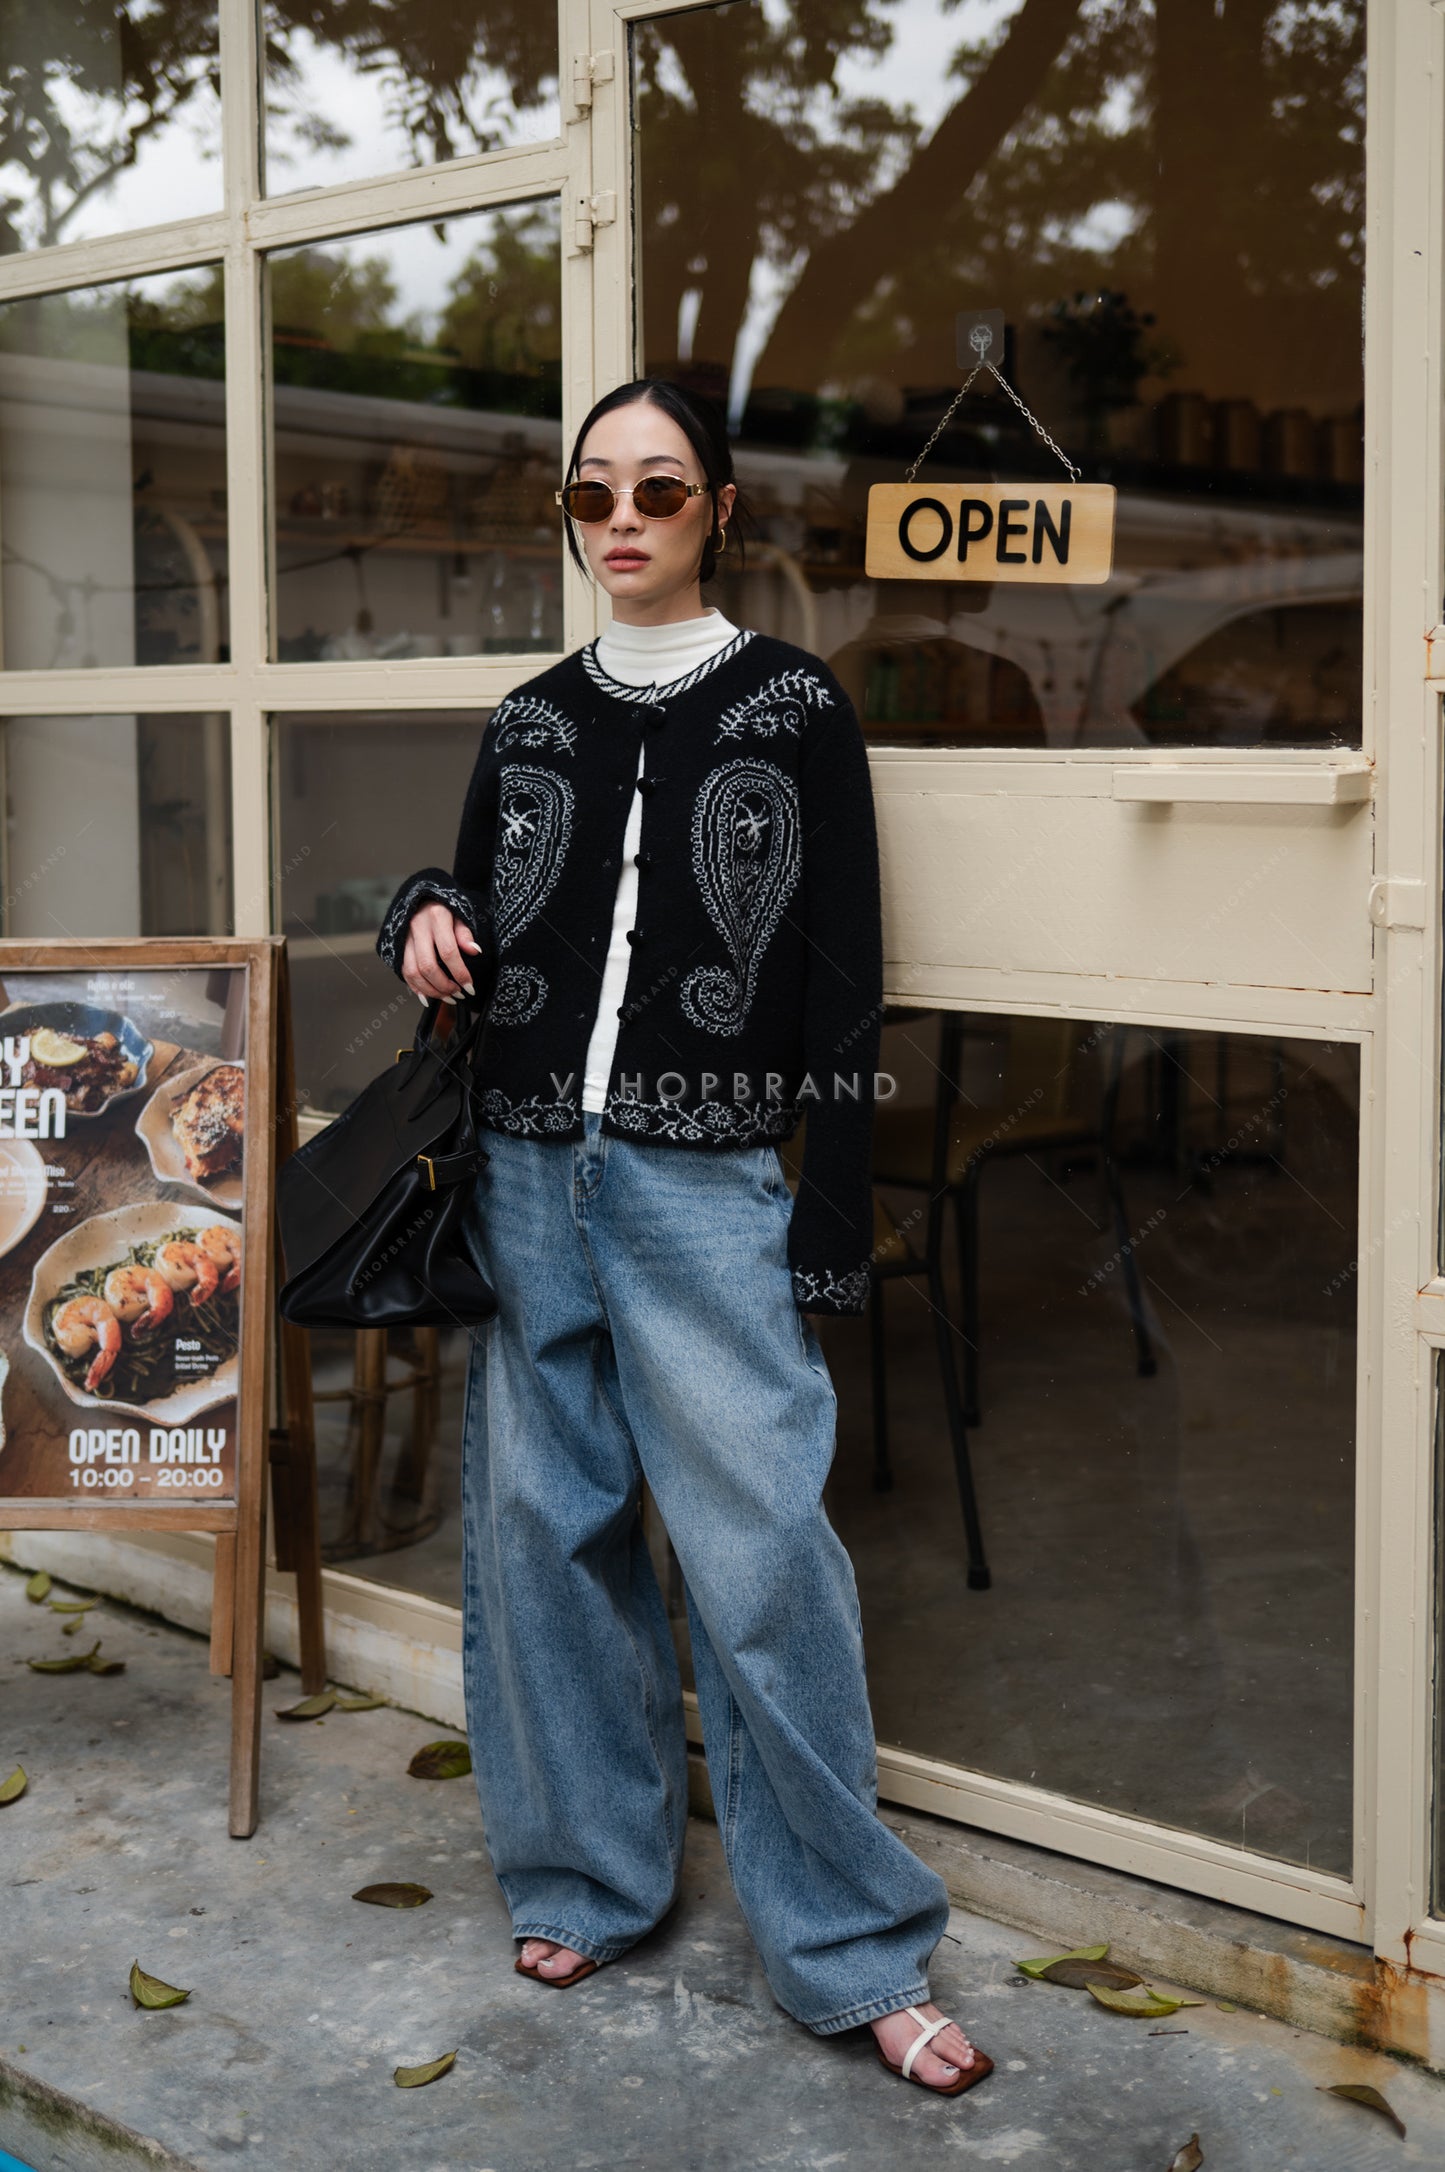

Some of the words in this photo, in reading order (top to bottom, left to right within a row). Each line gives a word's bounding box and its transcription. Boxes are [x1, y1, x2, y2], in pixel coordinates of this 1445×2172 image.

[898, 497, 1072, 565] OPEN
[176, 1338, 201, 1351] Pesto
[69, 1428, 141, 1465] OPEN
[149, 1428, 227, 1464] DAILY
[69, 1468, 134, 1488] 10:00
[157, 1468, 224, 1488] 20:00
